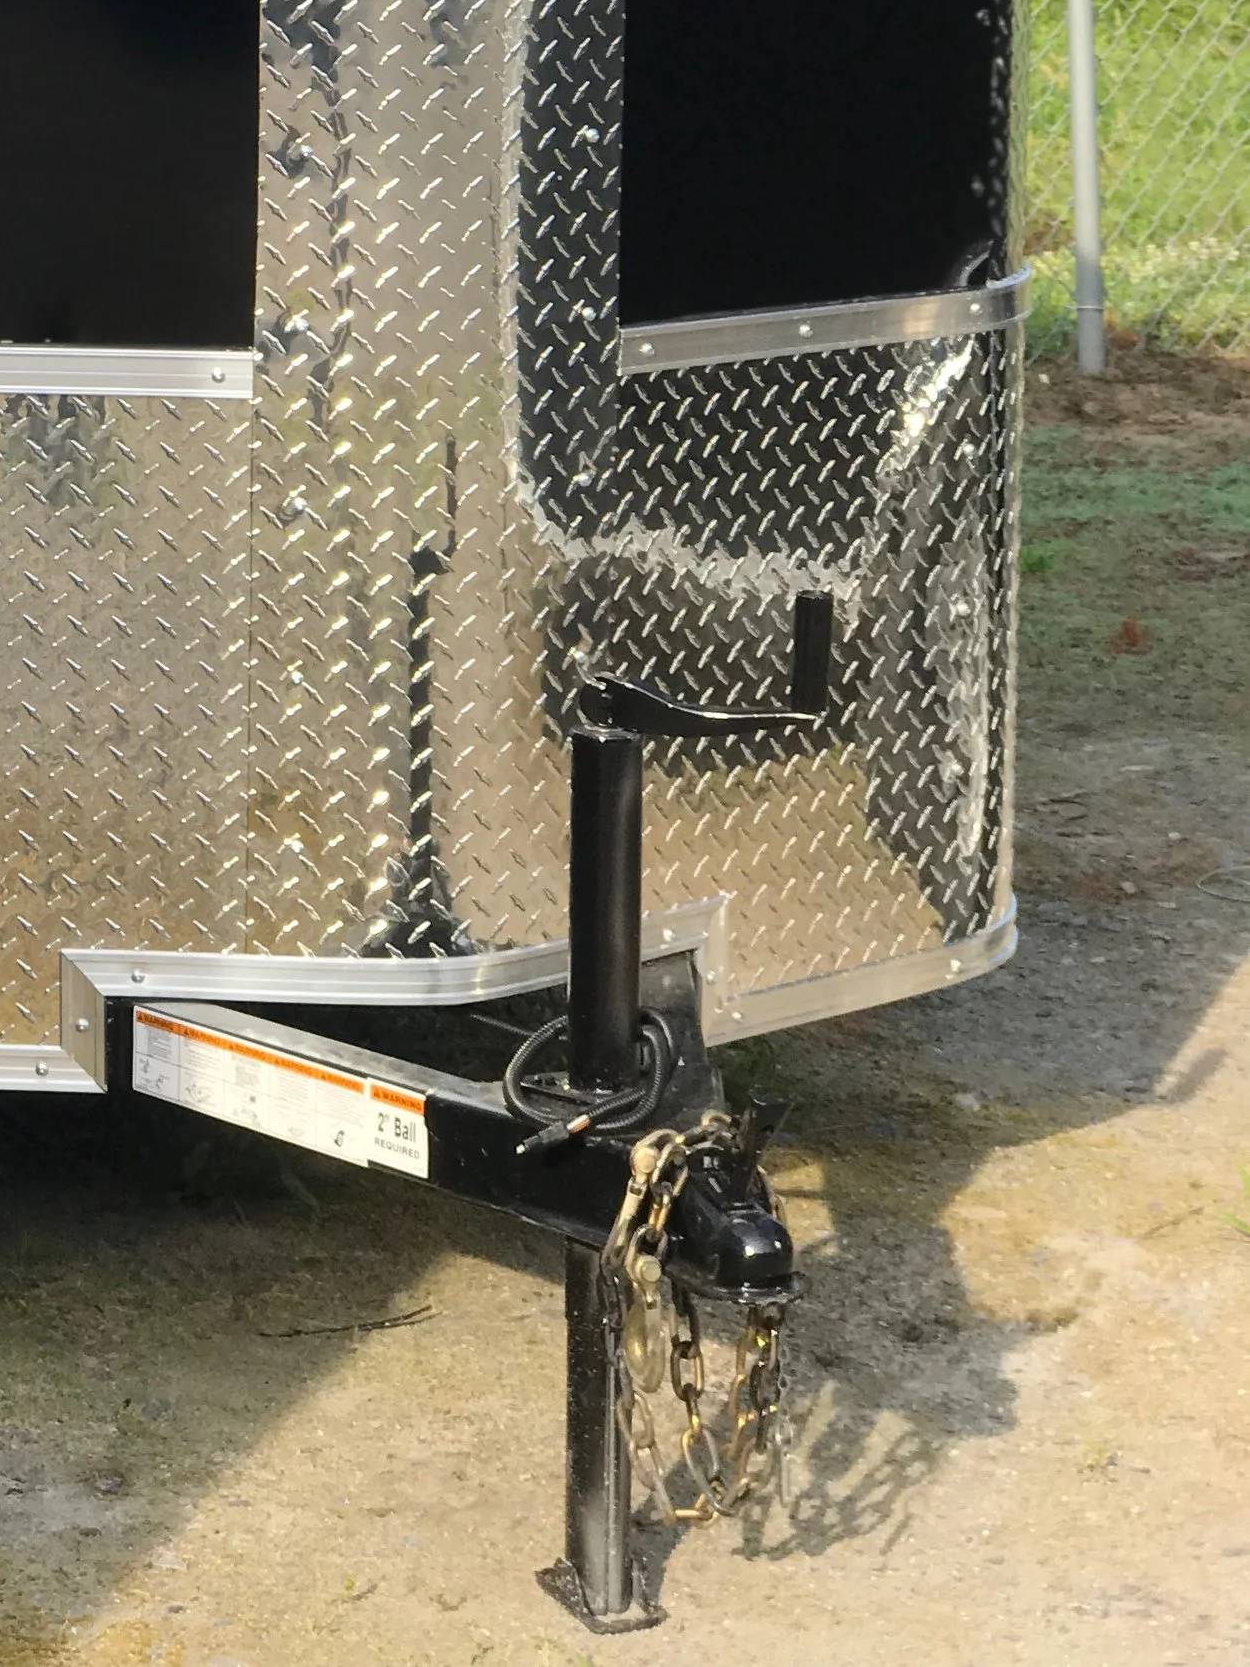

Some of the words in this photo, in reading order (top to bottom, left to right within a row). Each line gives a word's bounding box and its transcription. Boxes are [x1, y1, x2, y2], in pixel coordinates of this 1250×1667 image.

[382, 1092, 422, 1111] WARNING
[394, 1116, 417, 1143] Ball
[374, 1137, 420, 1159] REQUIRED
